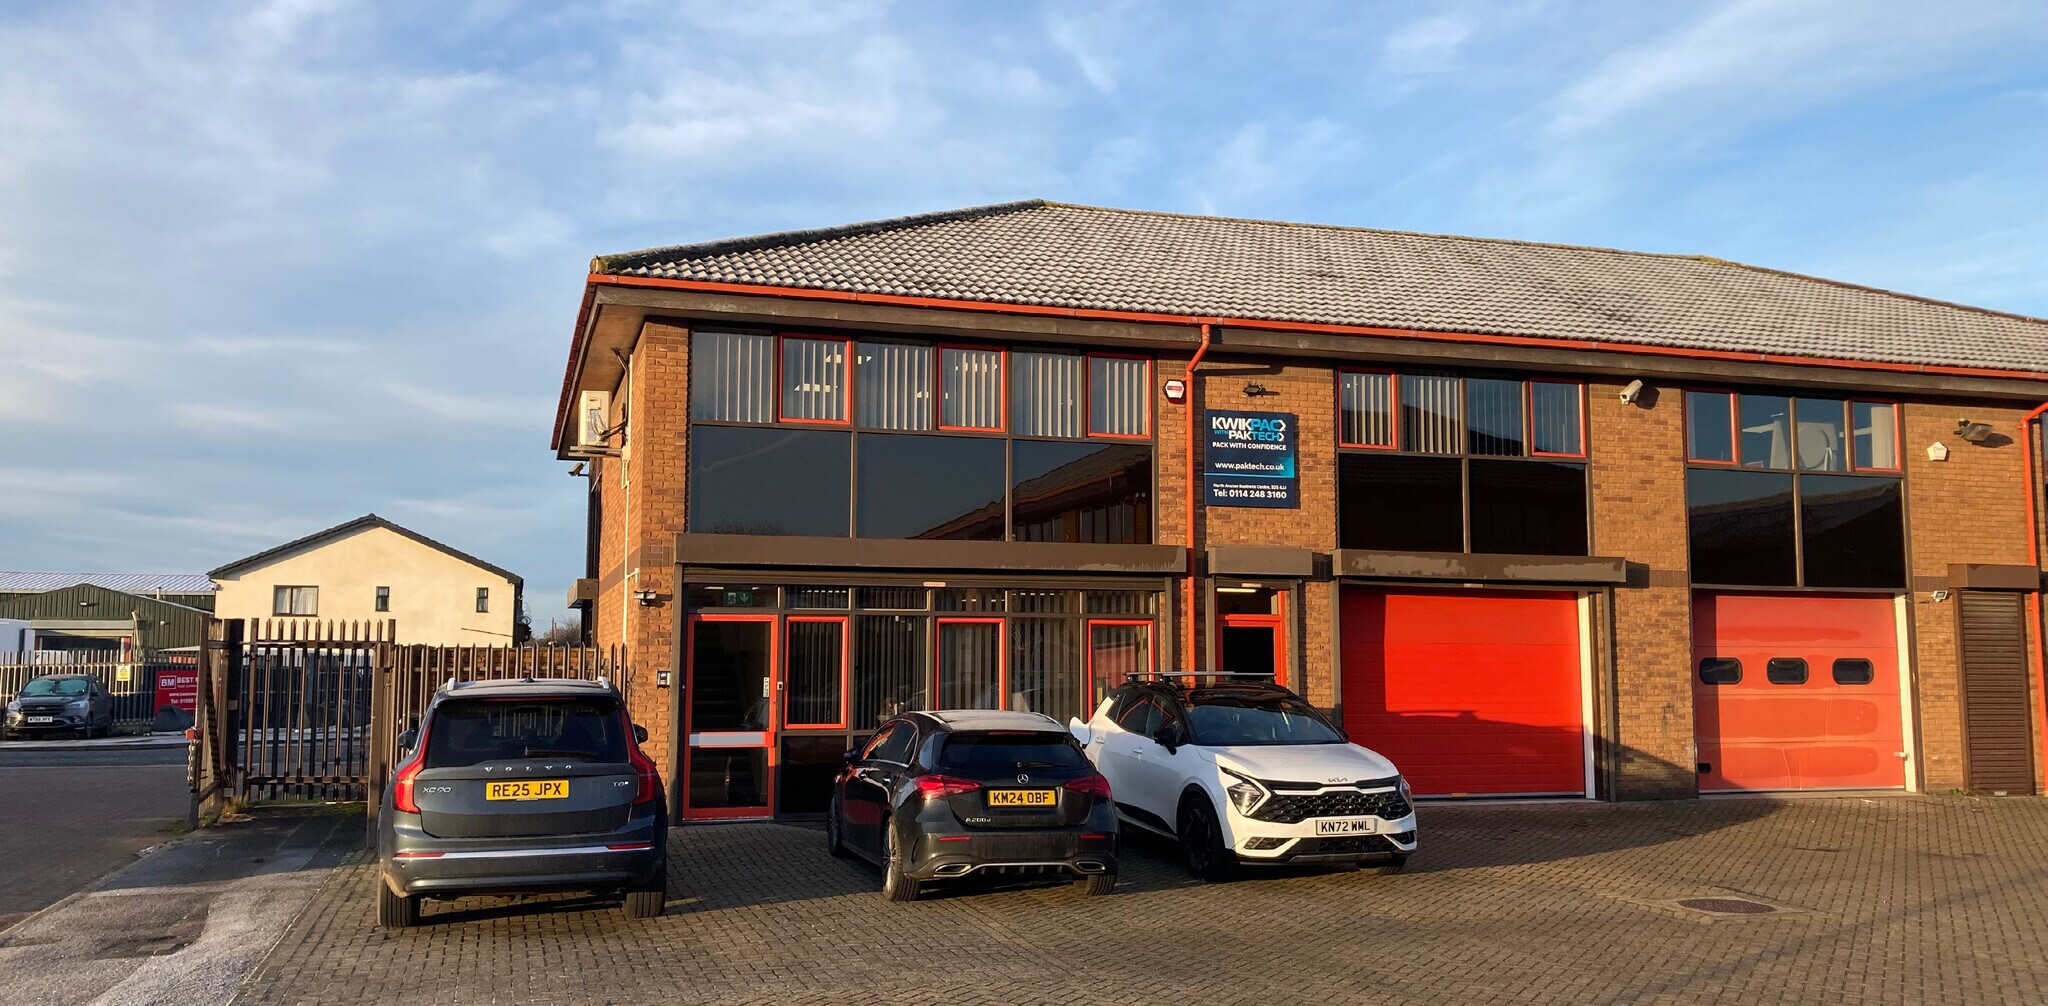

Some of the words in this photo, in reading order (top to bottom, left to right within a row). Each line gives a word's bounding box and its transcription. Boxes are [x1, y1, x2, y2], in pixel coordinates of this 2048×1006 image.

[1228, 430, 1280, 441] PAKTECH
[1247, 443, 1287, 451] CONFIDENCE
[1214, 462, 1285, 471] www.paktech.co.uk
[1212, 489, 1228, 497] Tel:
[1228, 489, 1248, 498] 0114
[1249, 490, 1266, 498] 248
[1266, 491, 1287, 499] 3160
[161, 678, 175, 687] BM
[484, 764, 572, 772] VOLVO
[493, 783, 530, 797] RE25
[534, 782, 562, 796] JPX
[993, 792, 1024, 803] KM24
[1027, 792, 1050, 803] OBF
[1321, 821, 1349, 832] KN72
[1351, 820, 1371, 831] WML
